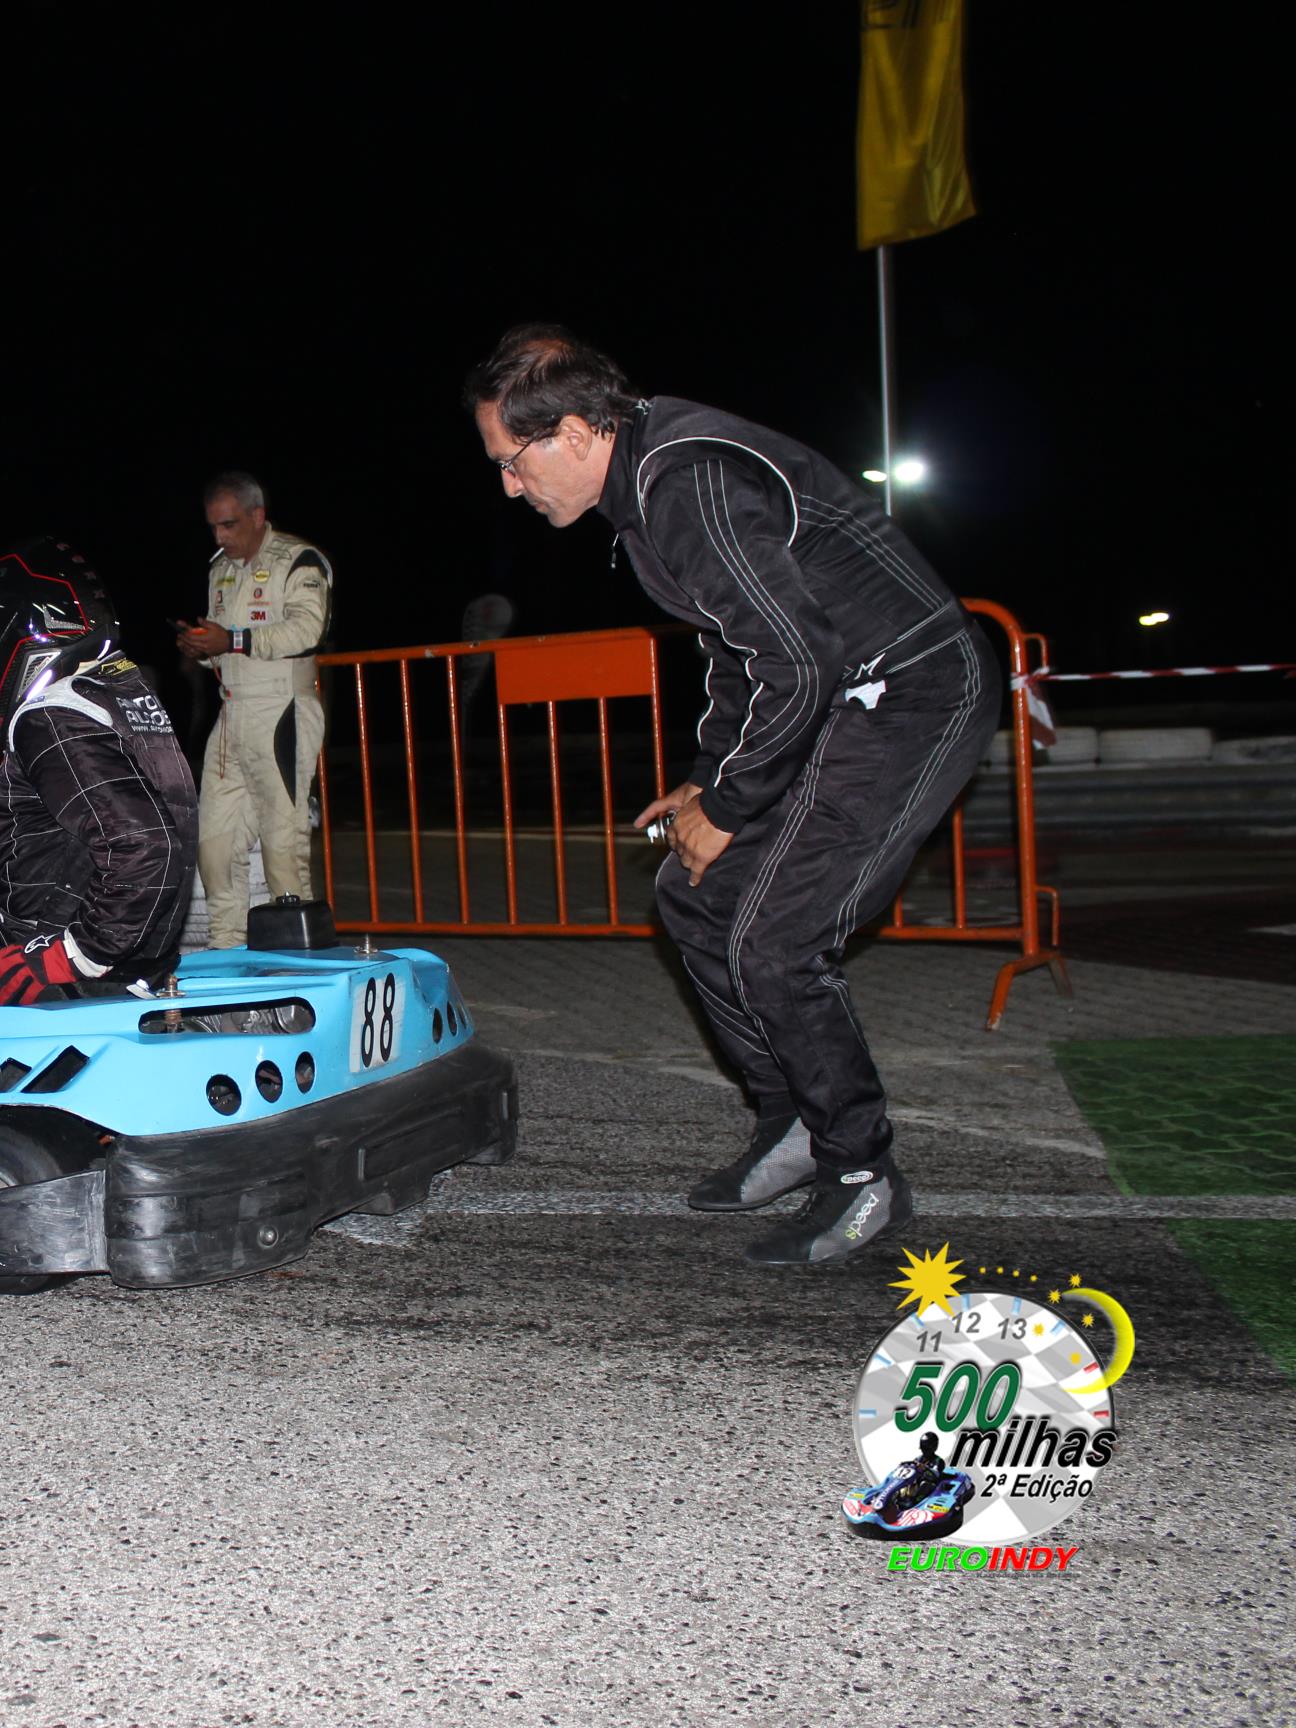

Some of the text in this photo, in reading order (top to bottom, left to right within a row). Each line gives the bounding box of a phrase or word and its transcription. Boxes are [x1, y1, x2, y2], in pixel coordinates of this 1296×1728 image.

[250, 611, 266, 621] 3M
[361, 972, 396, 1068] 88
[845, 1193, 880, 1240] speed
